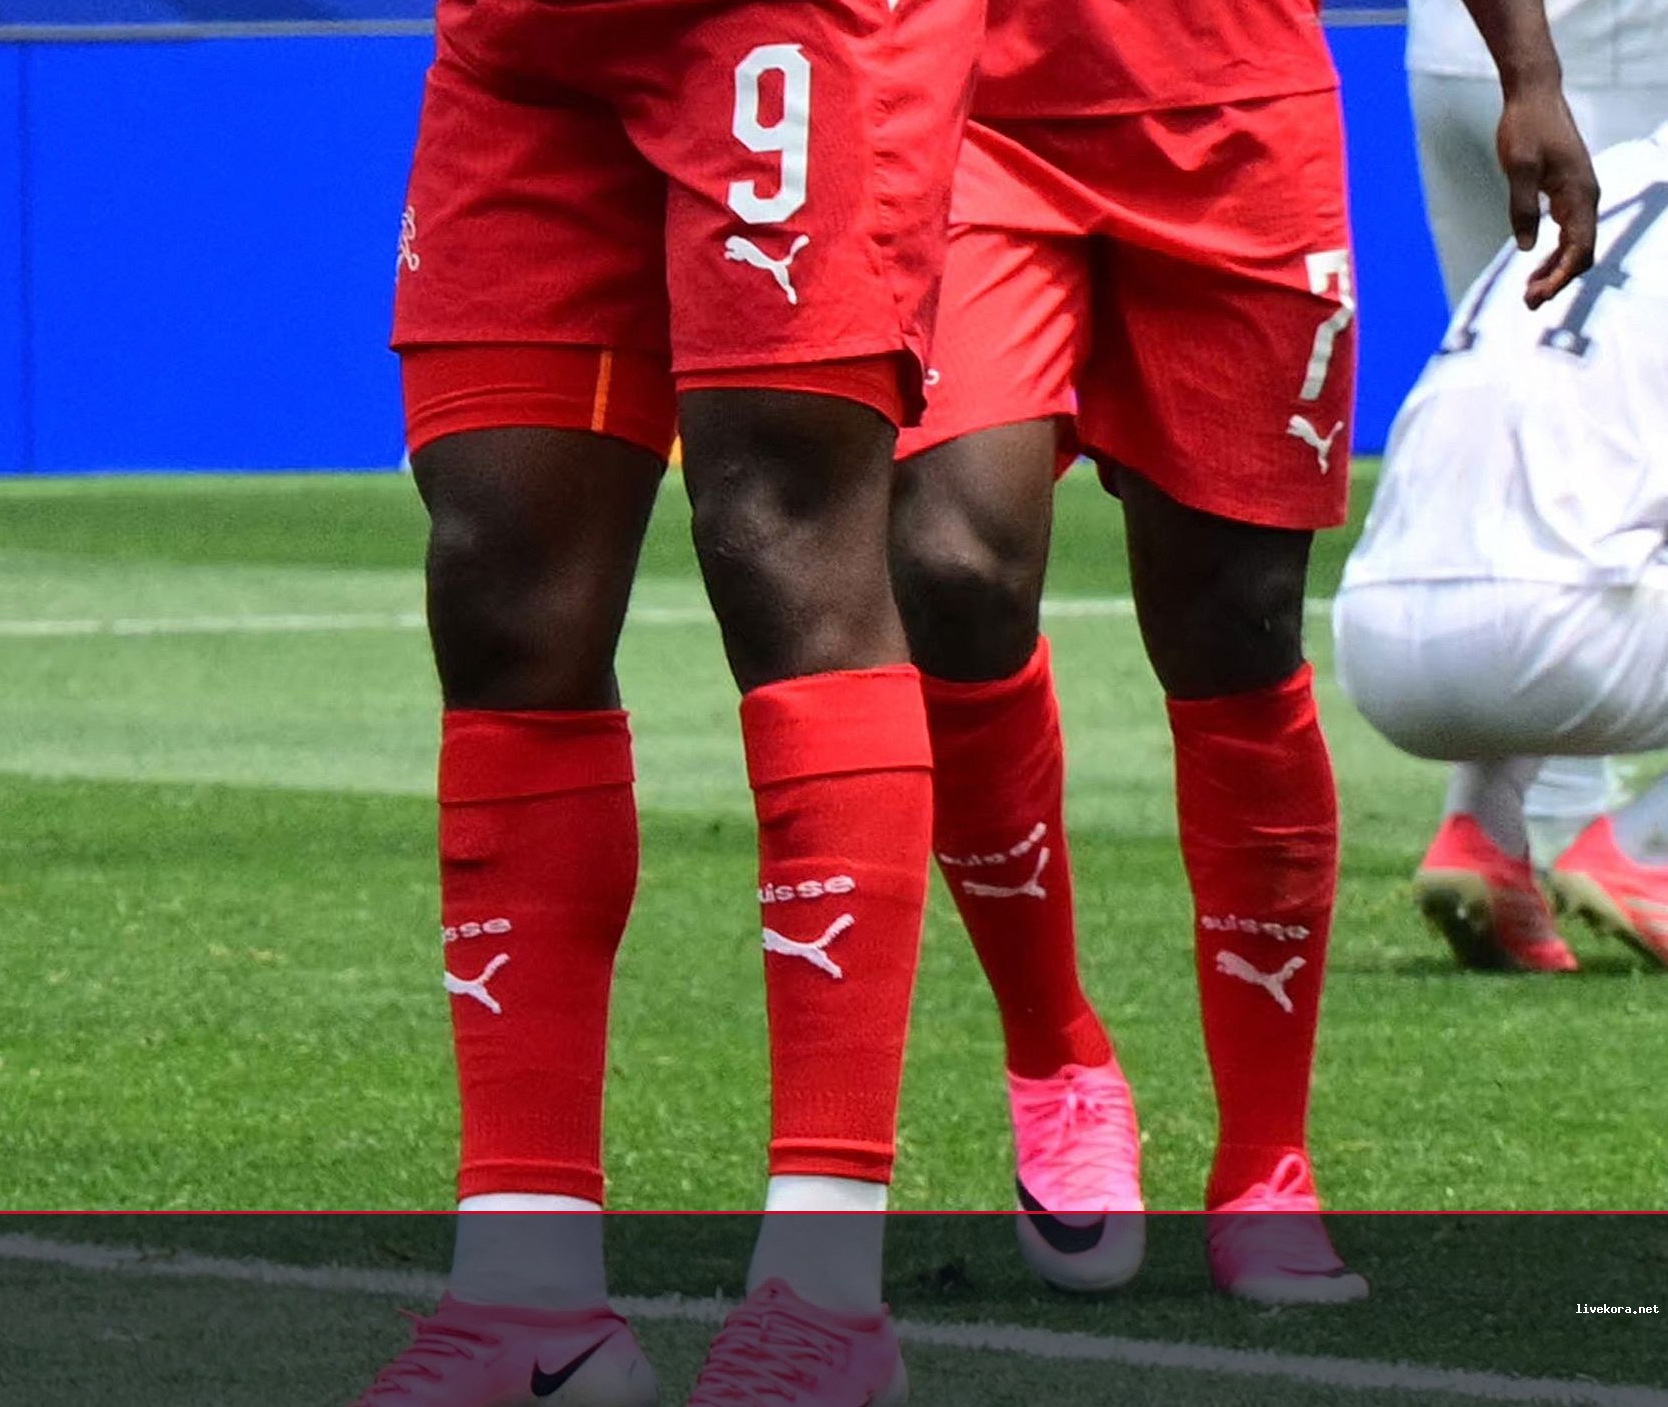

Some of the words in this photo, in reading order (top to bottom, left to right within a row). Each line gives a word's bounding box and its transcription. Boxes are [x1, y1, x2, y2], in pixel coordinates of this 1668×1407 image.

[727, 43, 812, 225] 9
[1299, 249, 1355, 402] 7
[757, 874, 856, 905] uisse
